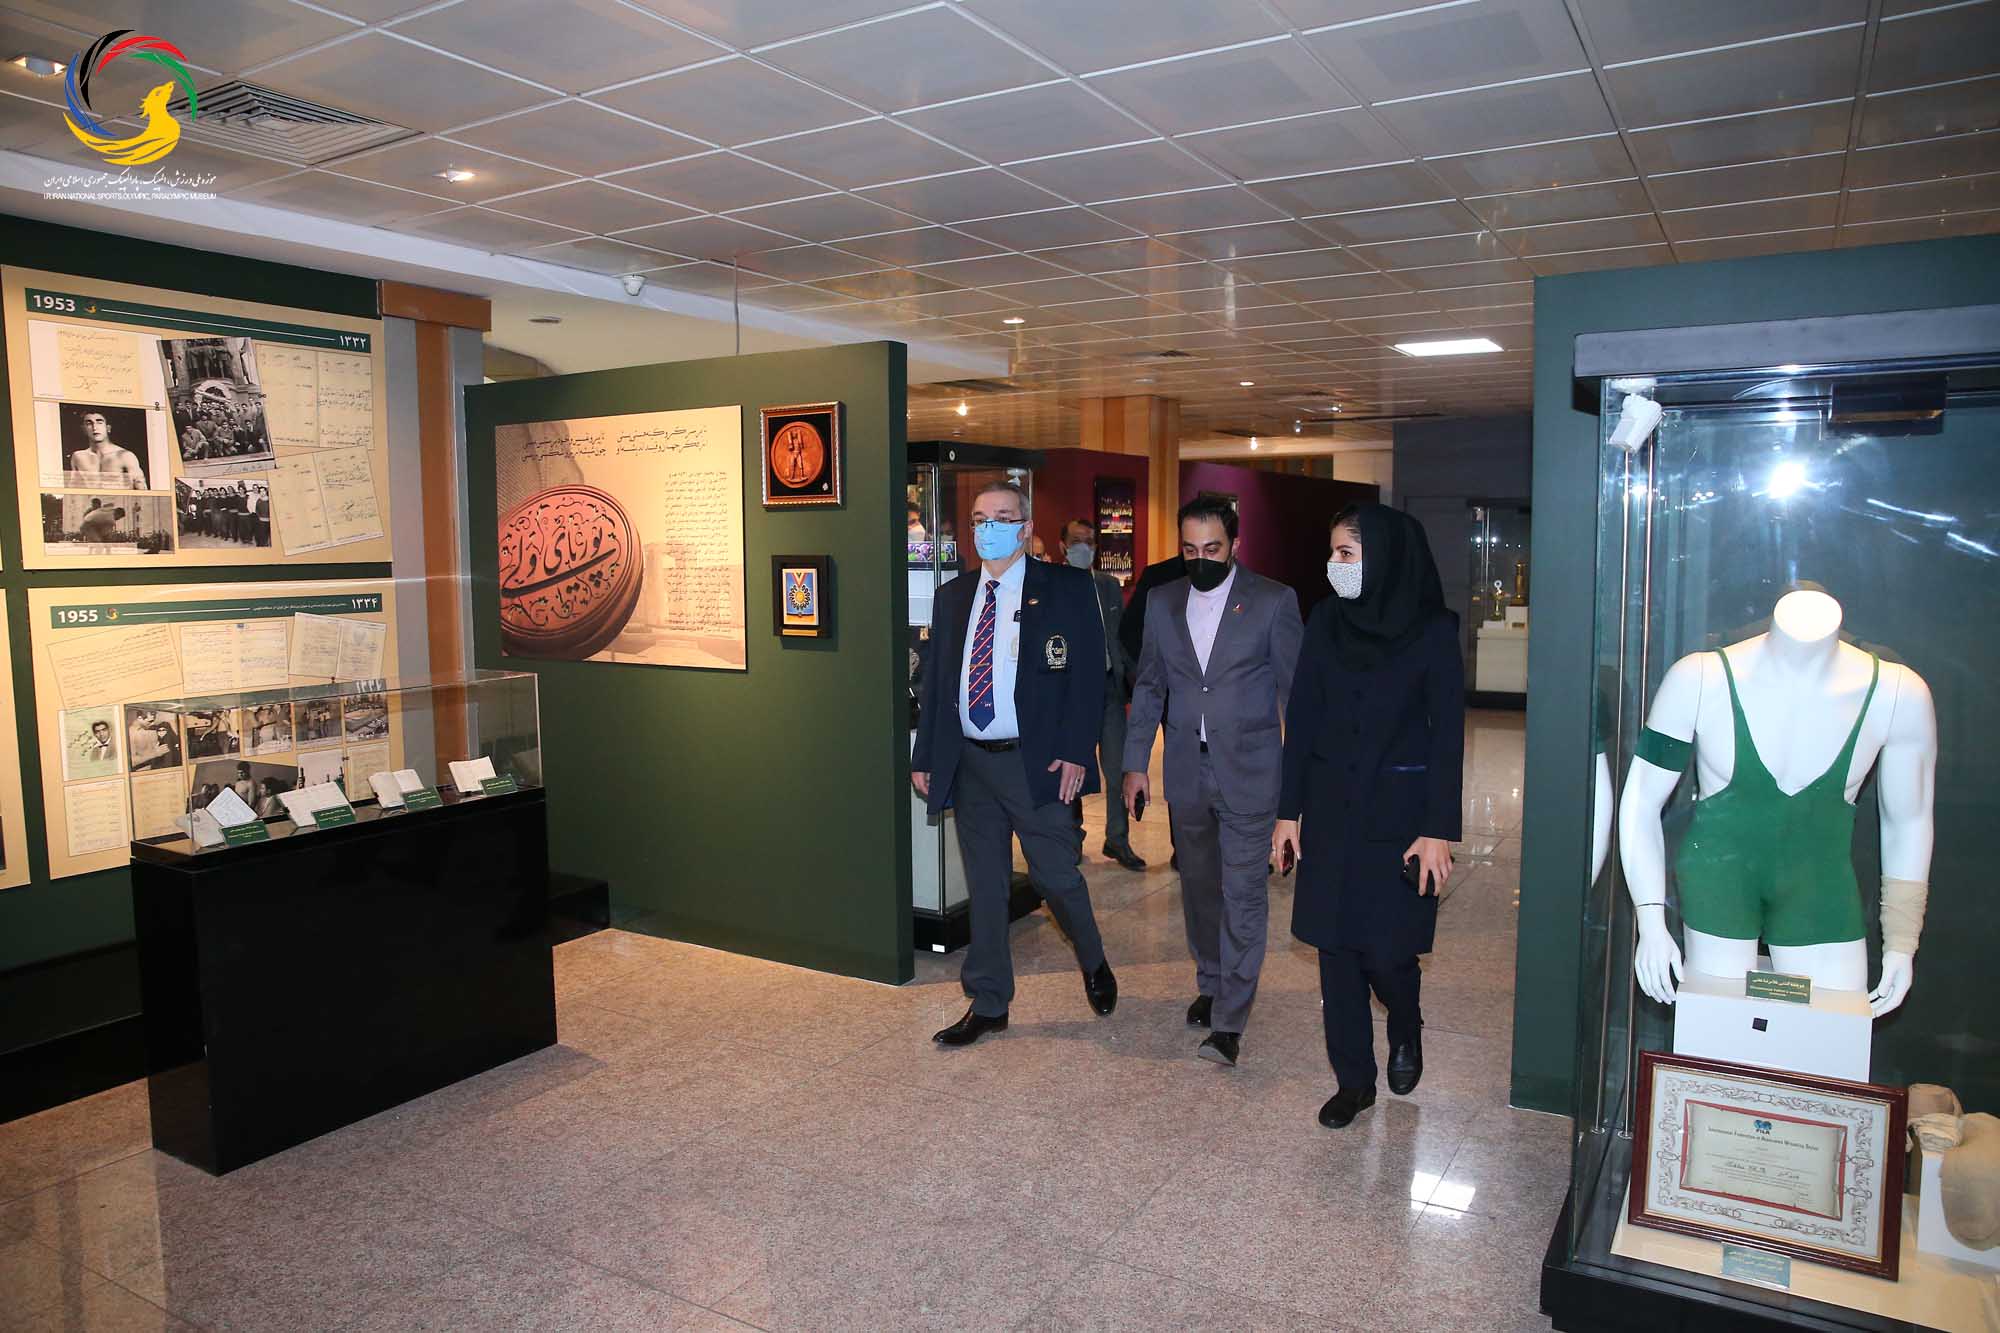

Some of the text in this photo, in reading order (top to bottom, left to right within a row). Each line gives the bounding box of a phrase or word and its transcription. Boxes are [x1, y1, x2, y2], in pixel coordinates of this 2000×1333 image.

[33, 294, 76, 312] 1953
[340, 335, 366, 349] ۱۳۳۲
[351, 597, 378, 609] ۱۳۳۴
[57, 609, 98, 623] 1955
